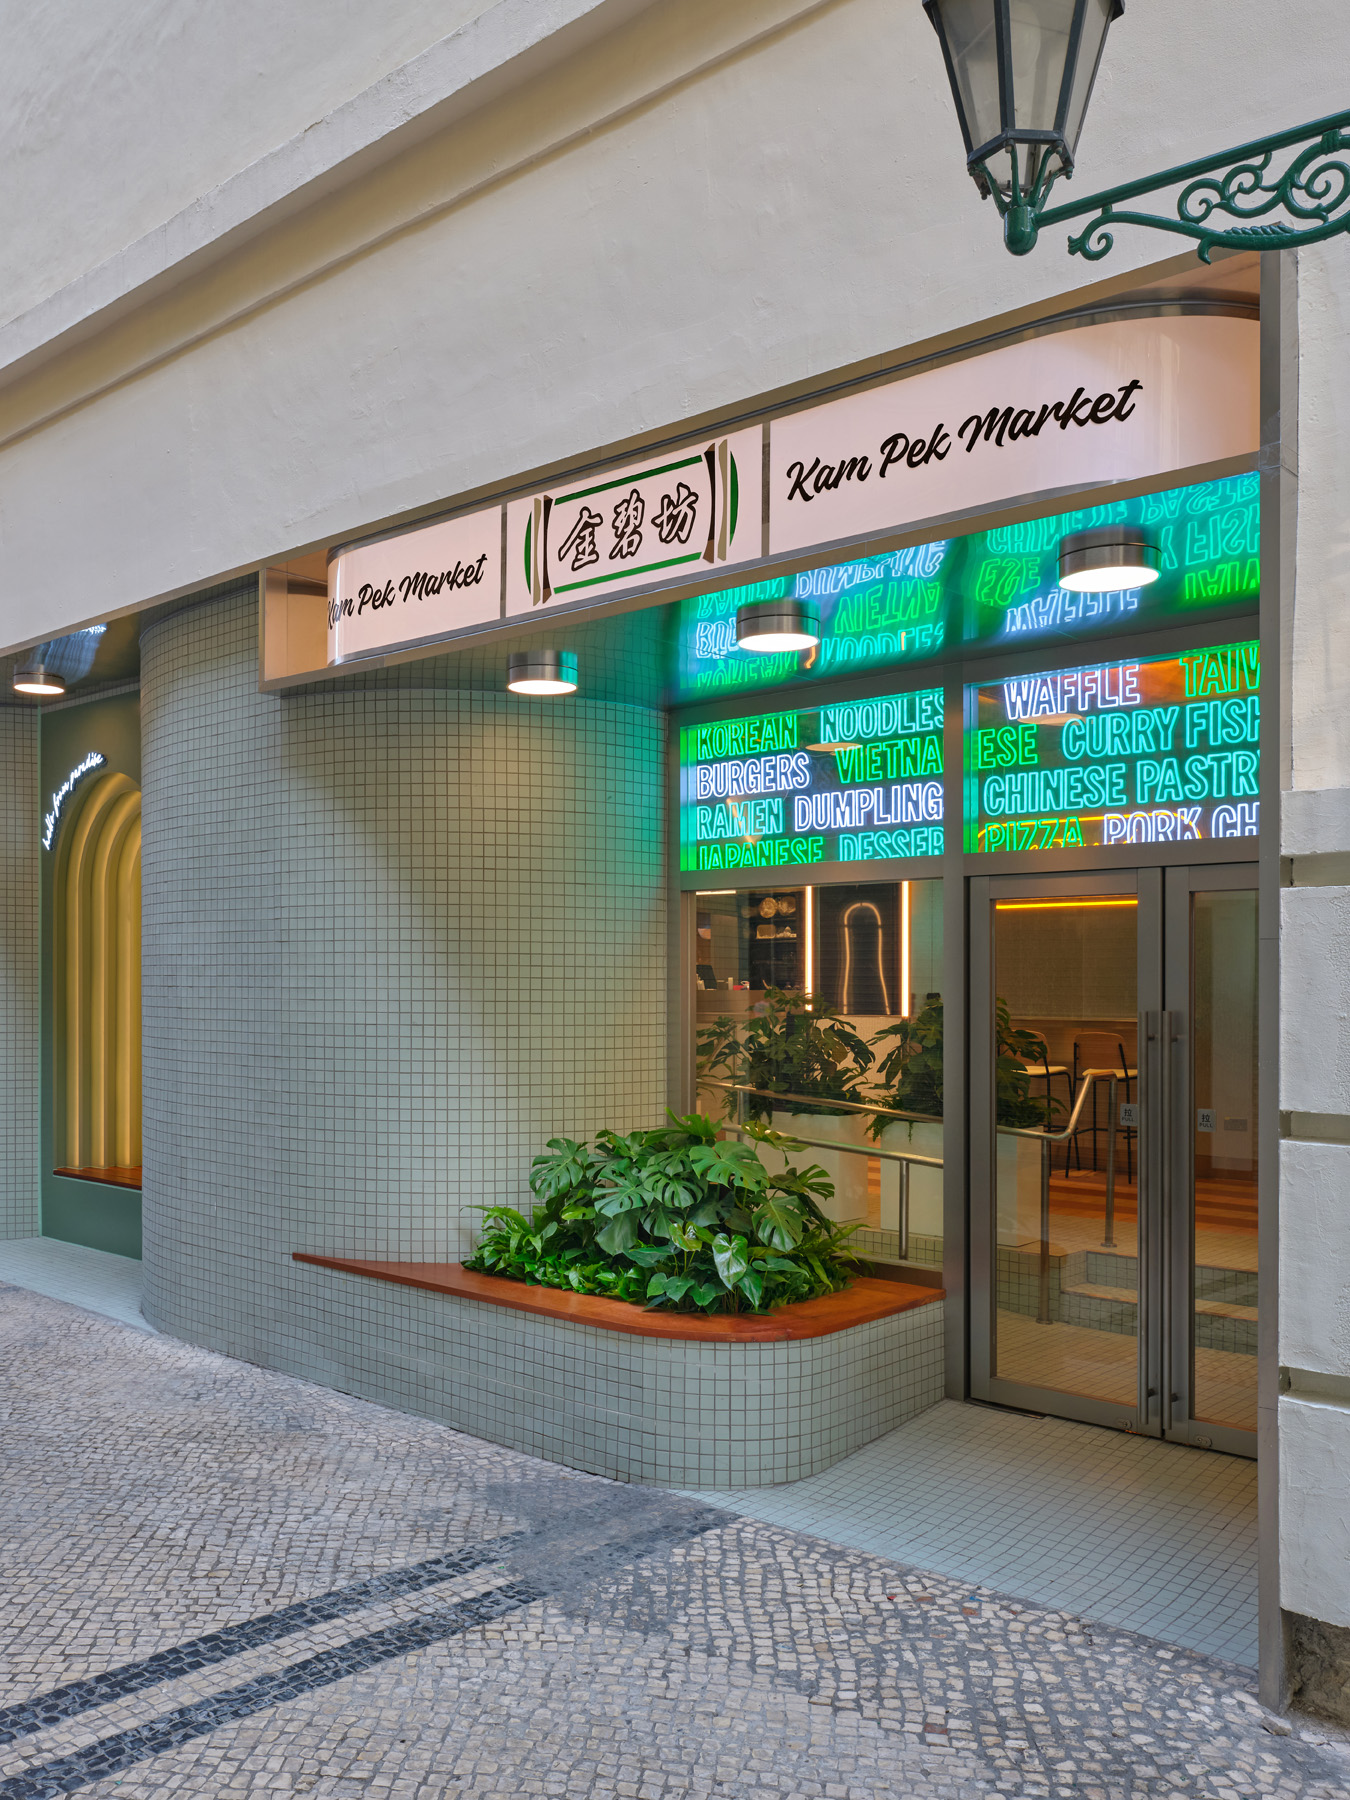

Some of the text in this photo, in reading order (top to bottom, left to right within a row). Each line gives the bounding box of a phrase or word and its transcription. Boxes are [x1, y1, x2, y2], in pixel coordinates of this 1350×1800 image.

[786, 379, 1143, 502] Kam Pek Market
[557, 481, 700, 572] 金碧坊
[357, 579, 396, 616] Pek
[398, 553, 488, 602] Market
[1003, 664, 1141, 720] WAFFLE
[697, 713, 797, 760] KOREAN
[978, 723, 1038, 769] ESE
[1062, 706, 1180, 760] CURRY
[697, 735, 943, 800] BURGERS VIETNA
[983, 750, 1260, 816] CHINESE PASTR
[697, 781, 943, 840] RAMEN DUMPLING
[985, 816, 1084, 852] PIZZA
[1103, 806, 1202, 845] PORK
[1124, 1108, 1132, 1117] 拉
[1201, 1113, 1211, 1123] 拉
